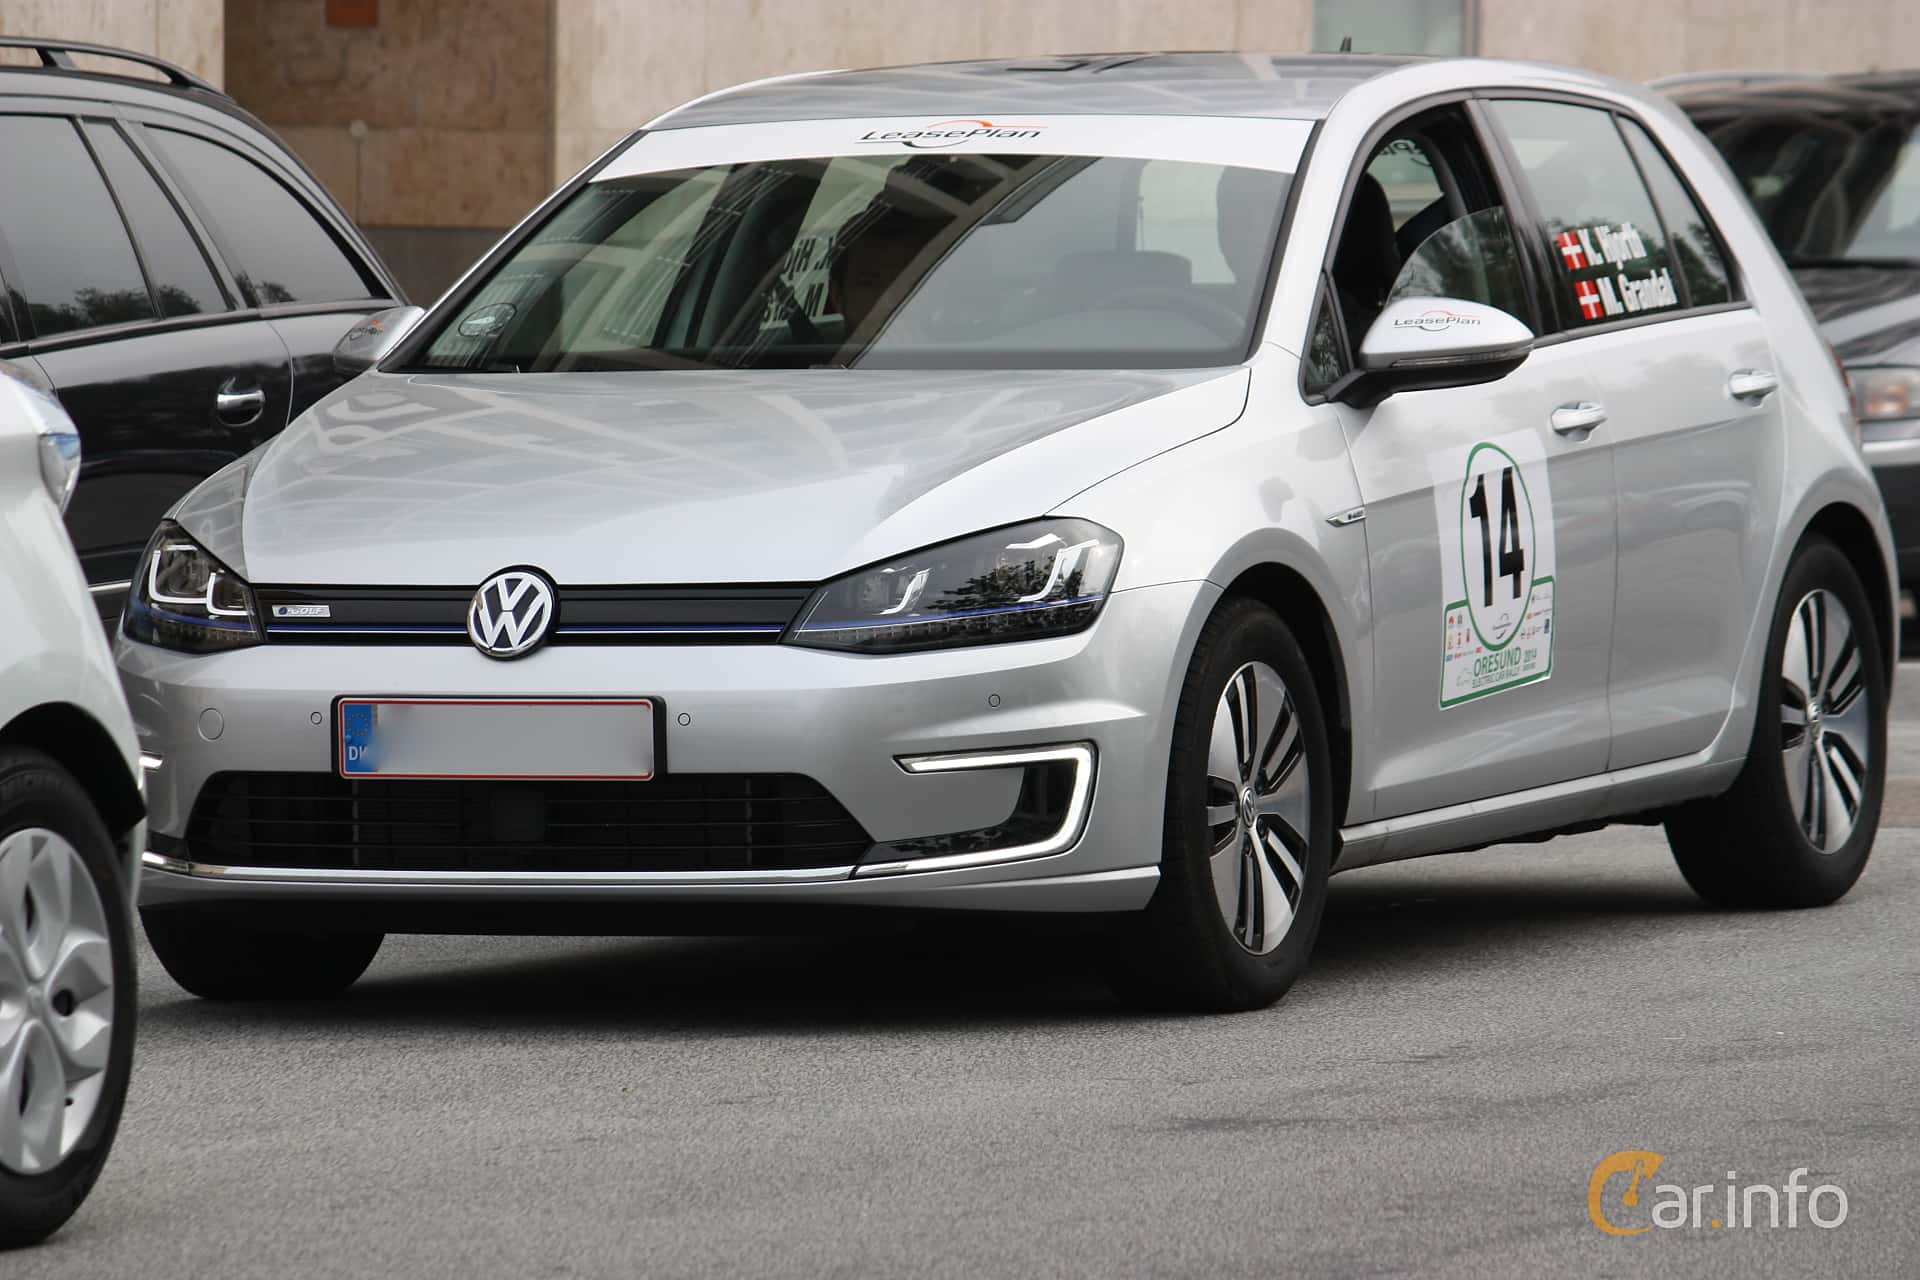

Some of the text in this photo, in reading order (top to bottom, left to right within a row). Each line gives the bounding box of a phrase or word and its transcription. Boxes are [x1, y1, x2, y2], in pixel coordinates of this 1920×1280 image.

[860, 127, 1042, 141] LeasePlan
[1393, 316, 1481, 326] LeasePlan
[1469, 466, 1525, 607] 14
